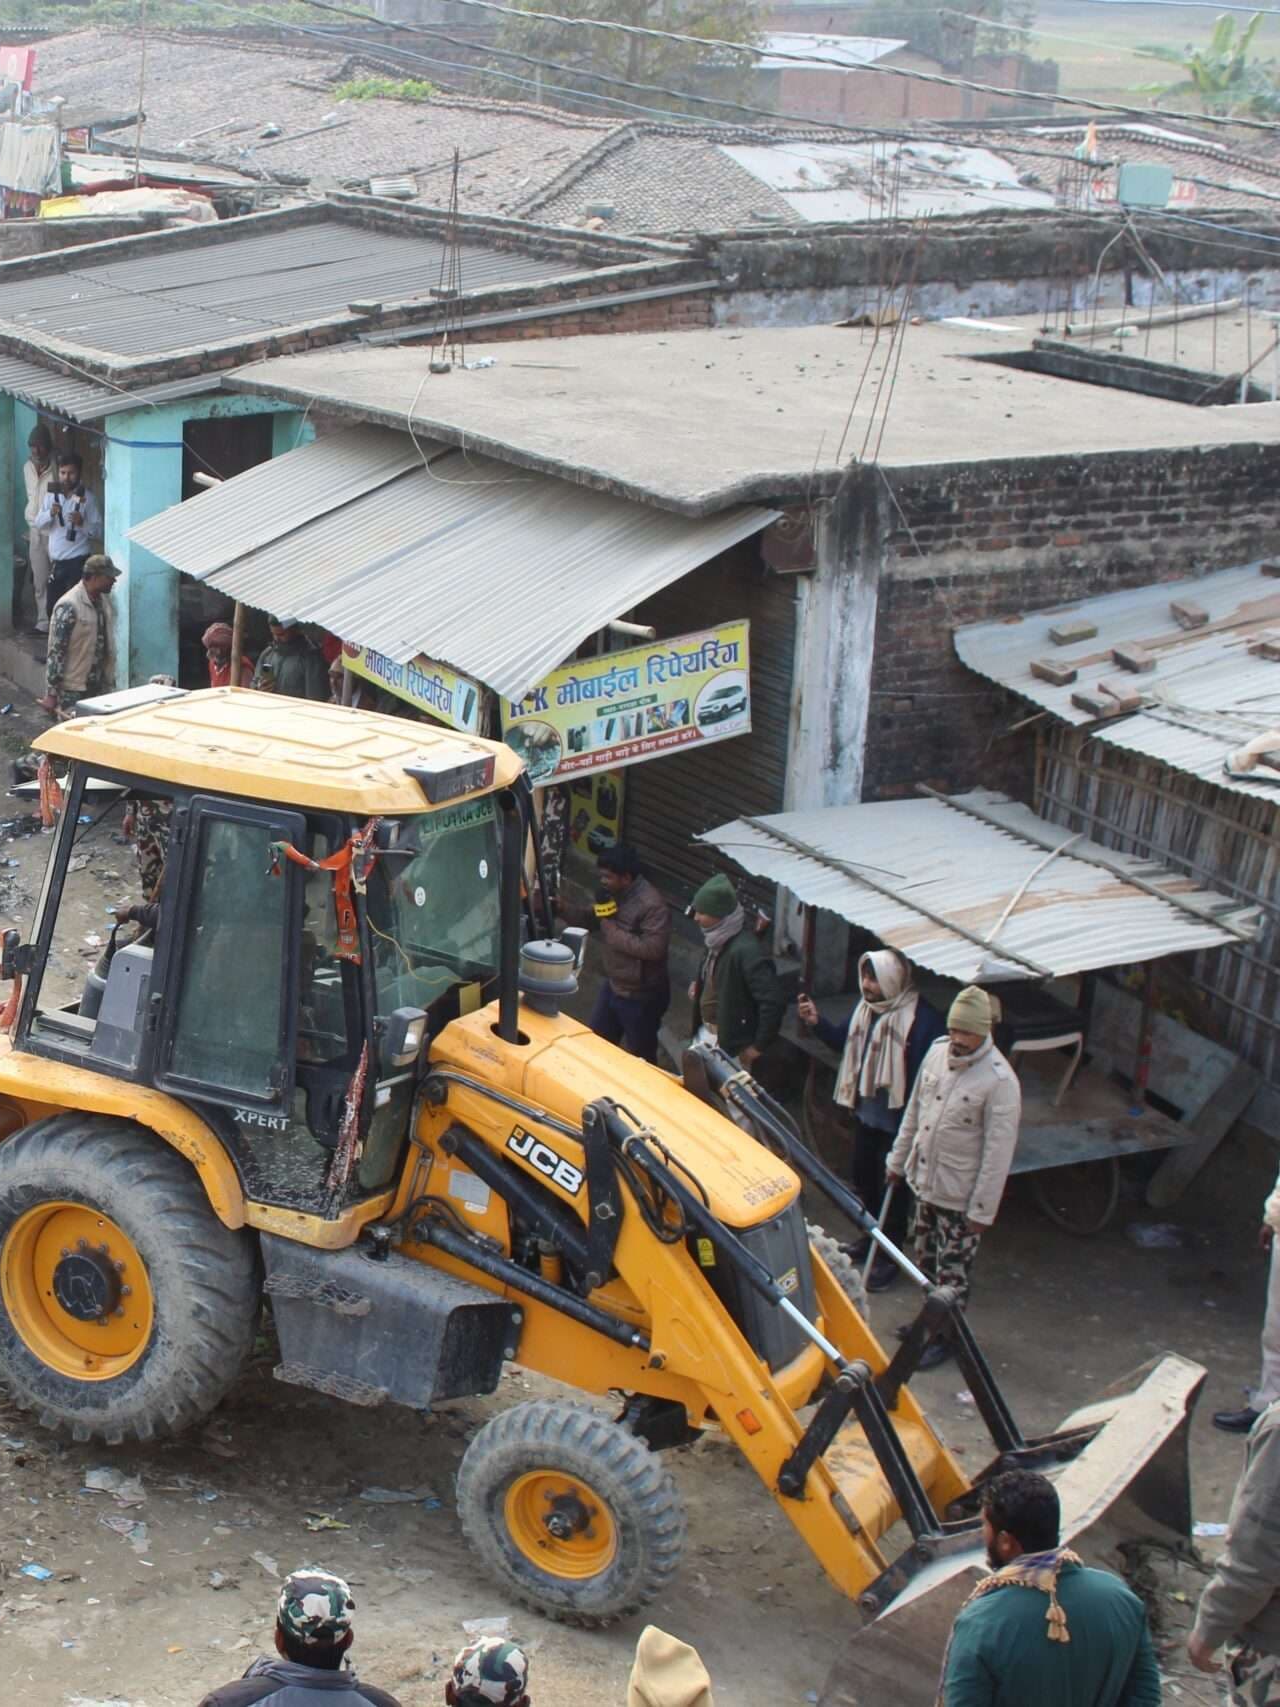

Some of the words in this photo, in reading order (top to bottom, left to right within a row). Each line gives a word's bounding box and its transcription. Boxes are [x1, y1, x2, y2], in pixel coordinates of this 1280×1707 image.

[556, 666, 640, 705] मोबाईल
[647, 639, 739, 684] रिपेयरिंग
[233, 1109, 290, 1130] XPERT
[509, 1136, 583, 1193] JCB
